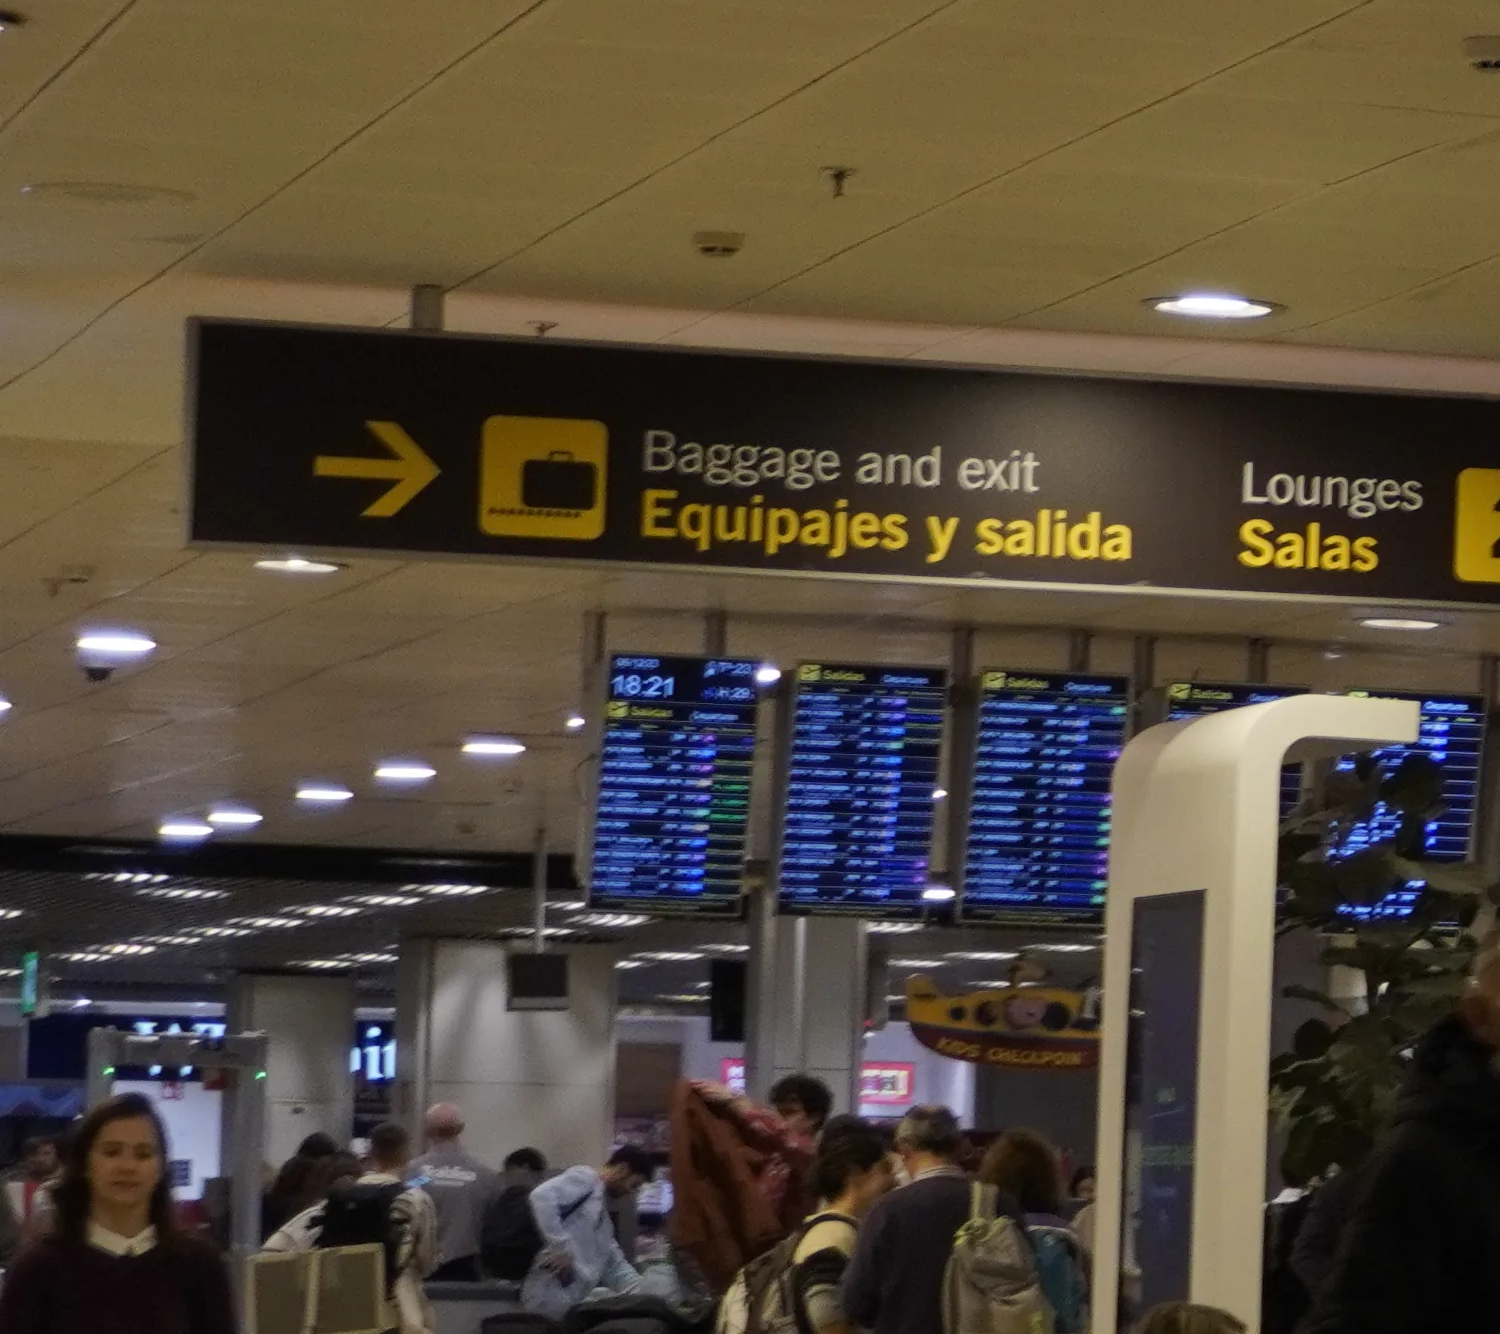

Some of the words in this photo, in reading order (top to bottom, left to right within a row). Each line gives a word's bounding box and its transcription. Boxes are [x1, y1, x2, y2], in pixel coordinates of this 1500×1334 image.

[643, 429, 841, 491] Baggage
[853, 446, 942, 487] and
[956, 450, 1042, 493] exit
[1240, 462, 1424, 519] Lounges
[640, 488, 909, 559] Equipajes
[926, 516, 960, 563] y
[974, 508, 1134, 561] salida
[1237, 519, 1380, 573] Salas
